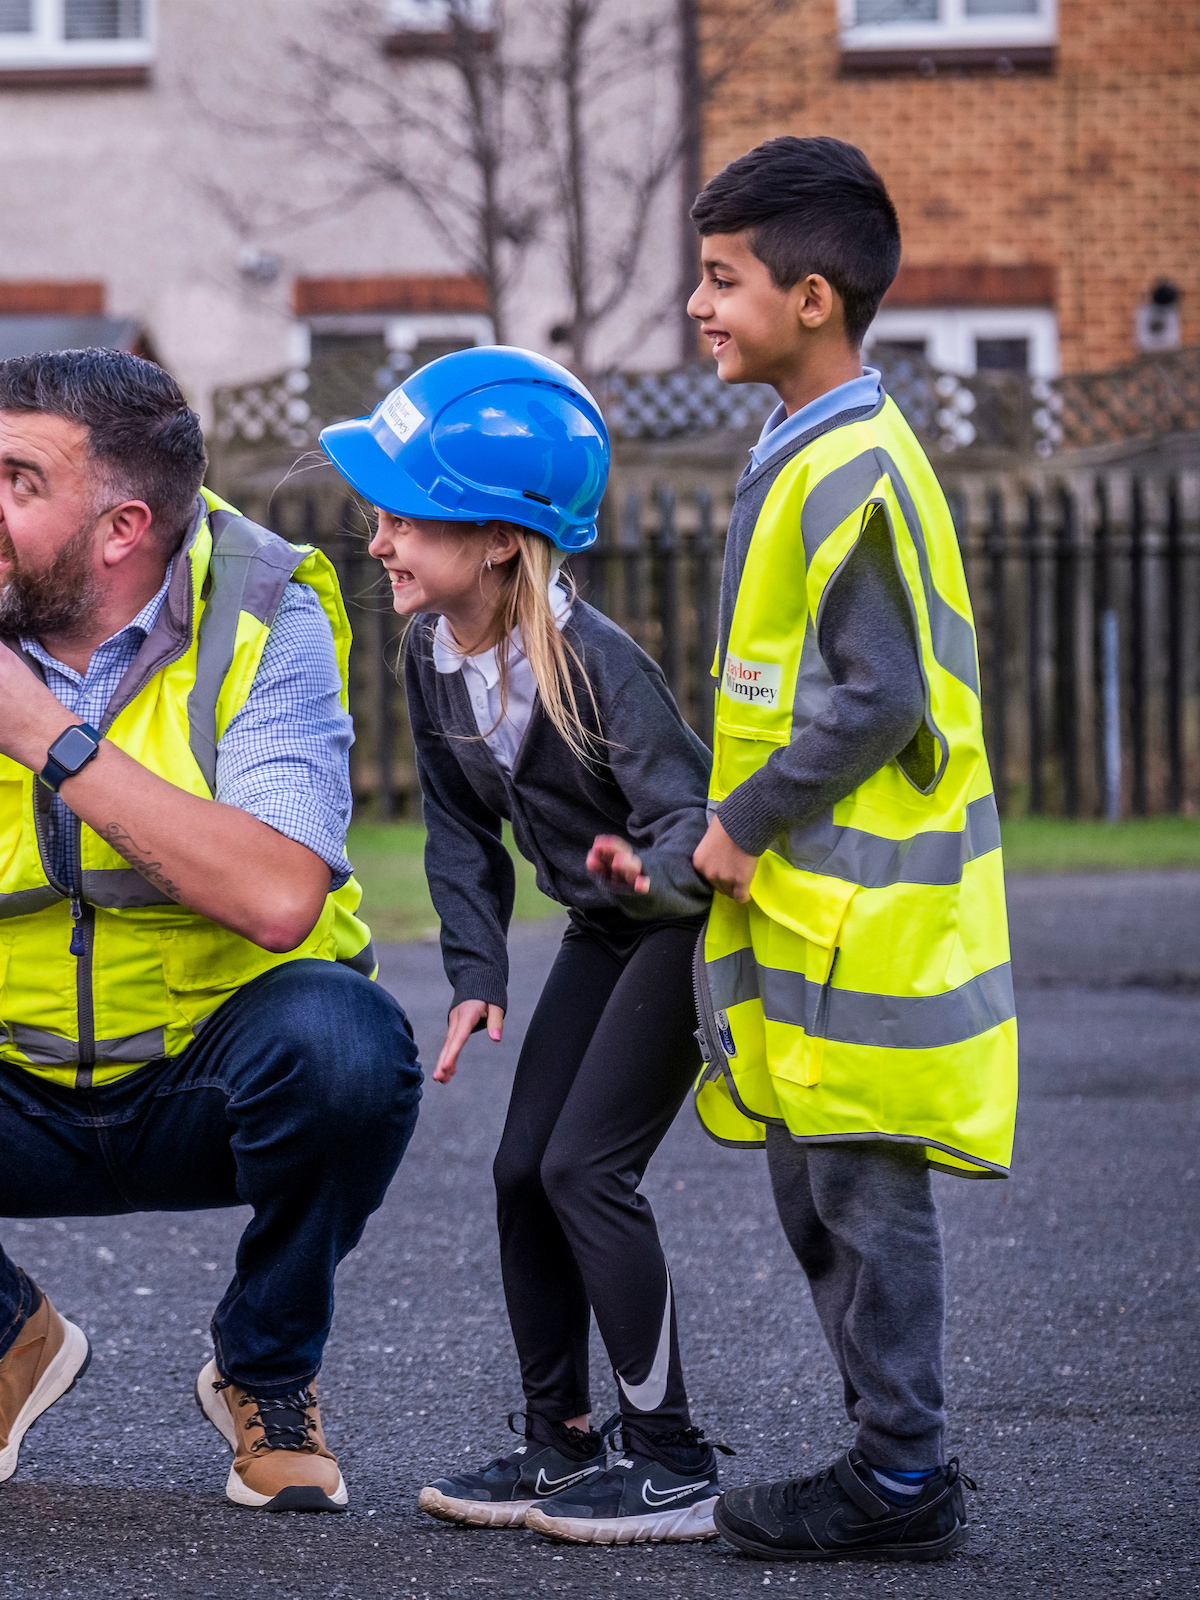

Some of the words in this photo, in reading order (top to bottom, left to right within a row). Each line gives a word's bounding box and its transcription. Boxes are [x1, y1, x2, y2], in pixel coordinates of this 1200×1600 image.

[387, 402, 410, 434] Wimpey
[393, 395, 411, 418] Taylor
[726, 657, 762, 681] Taylor
[725, 672, 778, 704] Wimpey
